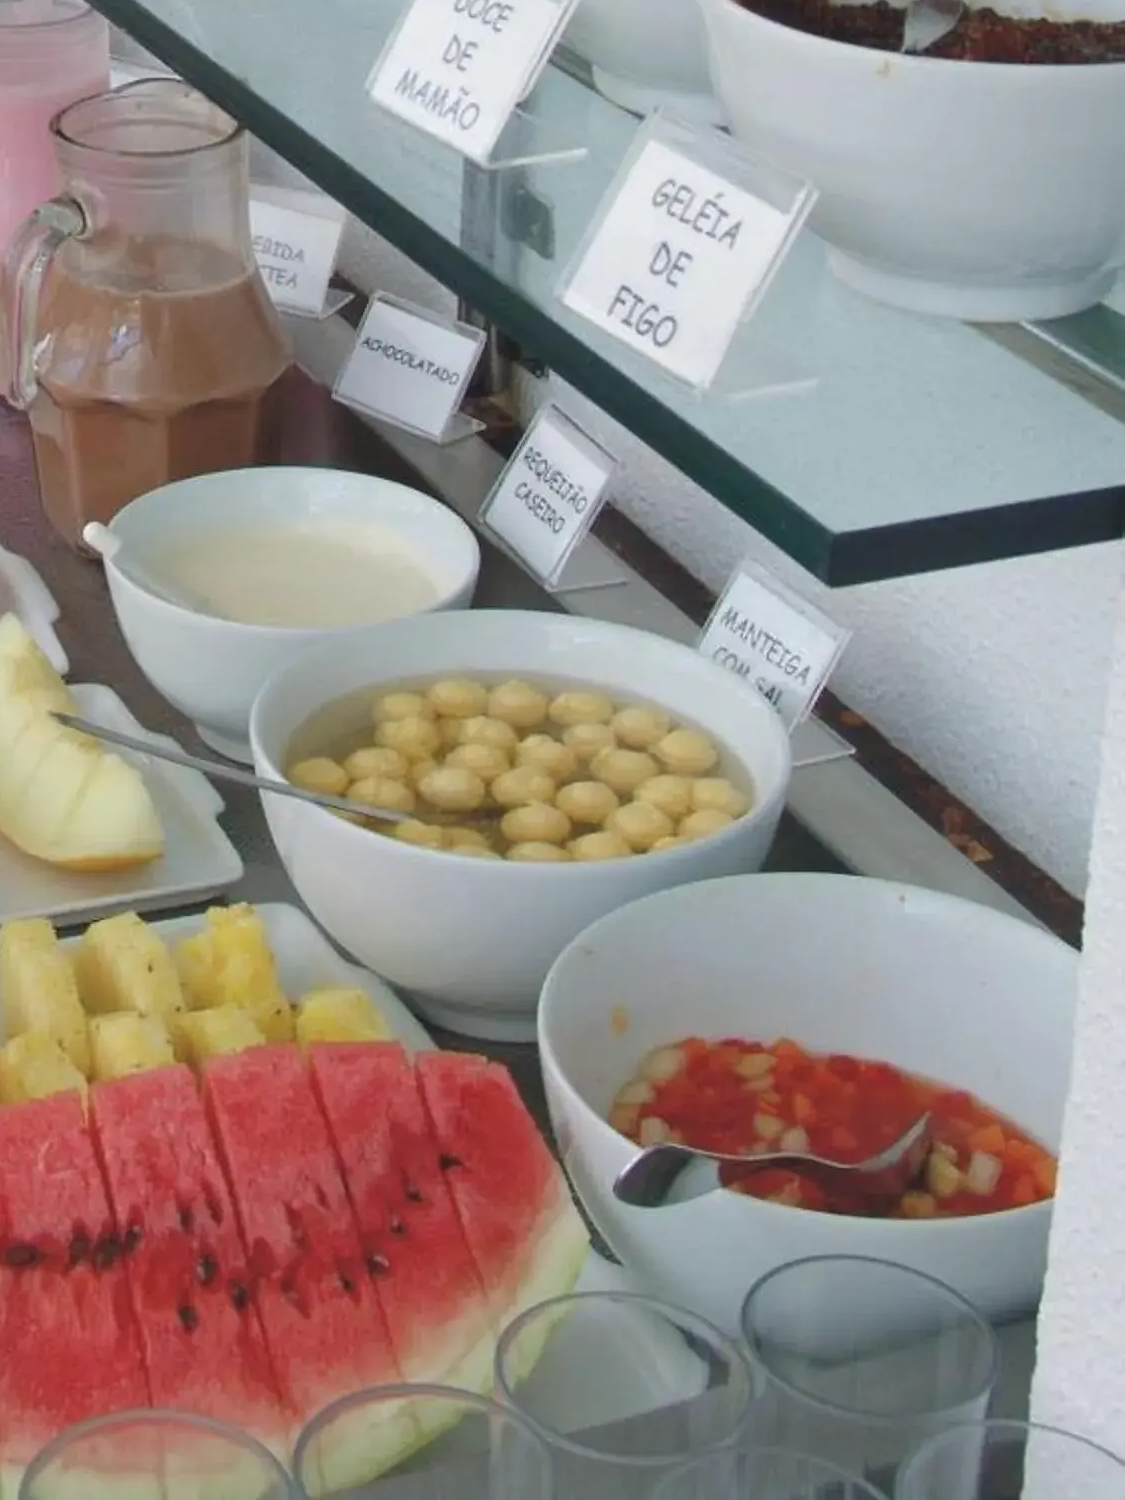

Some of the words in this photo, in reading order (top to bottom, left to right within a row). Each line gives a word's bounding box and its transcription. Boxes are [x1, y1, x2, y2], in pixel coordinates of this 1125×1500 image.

[442, 33, 479, 72] DE
[394, 67, 481, 131] MAMÃO
[651, 178, 743, 250] GELÉIA
[252, 235, 306, 265] EBIDA
[649, 240, 694, 288] DE
[606, 284, 678, 348] FIGO
[361, 336, 460, 387] ACHOCOLATADO
[514, 482, 566, 534] CASEIRO
[720, 605, 811, 686] MANTEIGA
